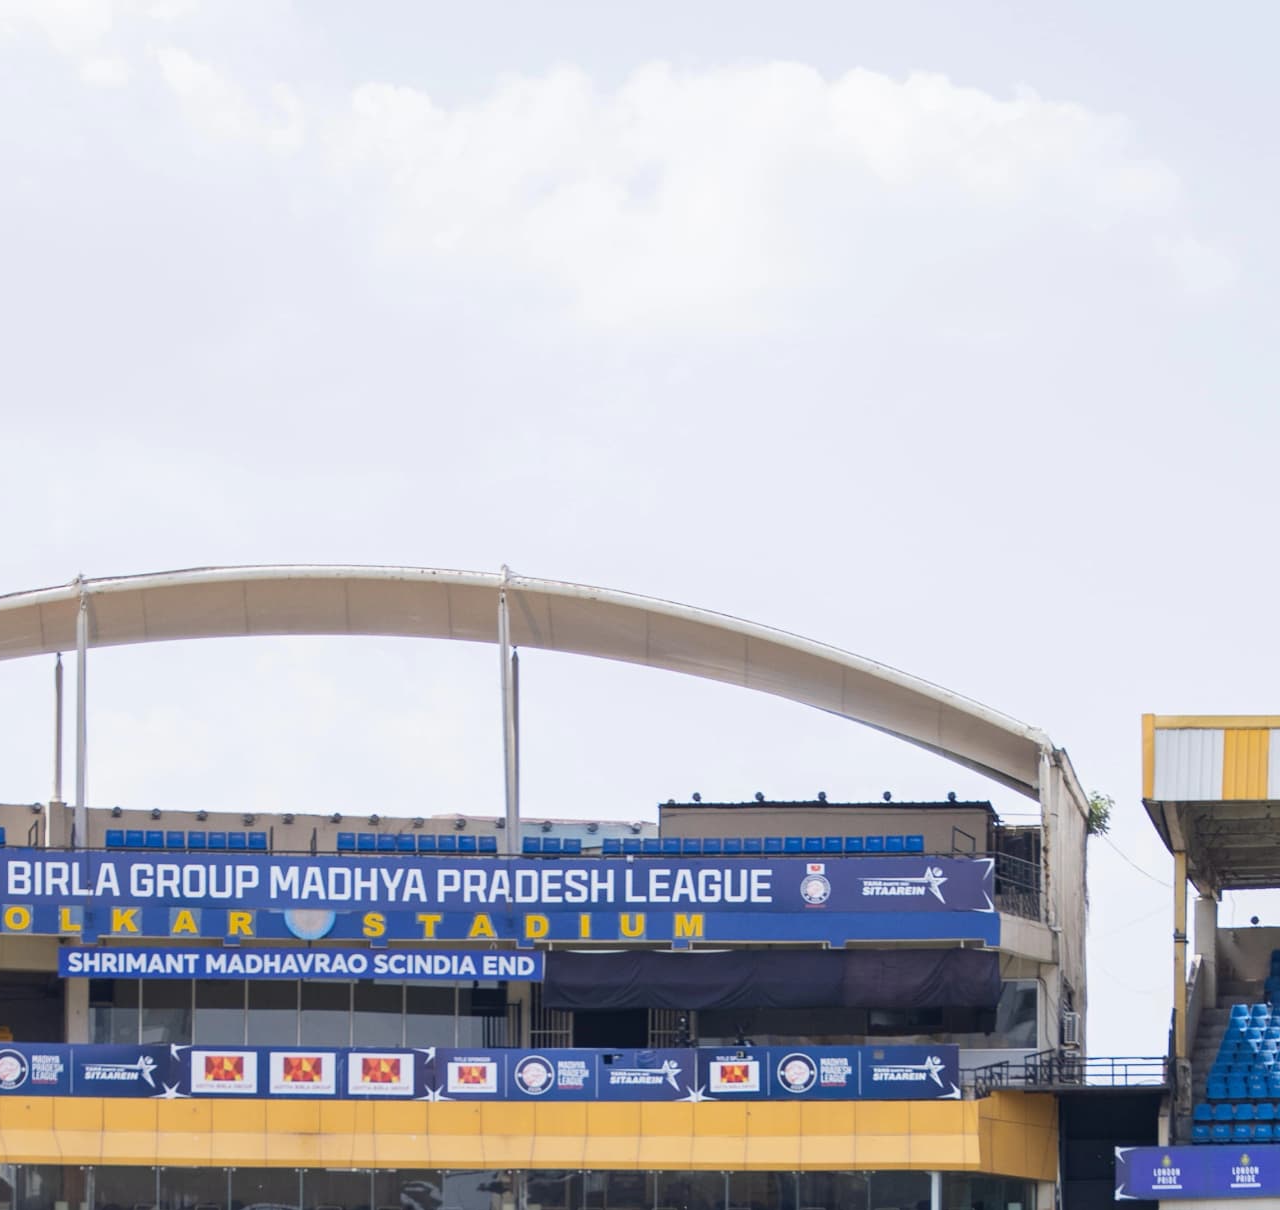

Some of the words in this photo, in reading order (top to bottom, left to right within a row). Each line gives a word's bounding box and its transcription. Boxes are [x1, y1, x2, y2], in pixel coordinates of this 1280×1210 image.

[7, 860, 120, 897] BIRLA
[130, 863, 260, 899] GROUP
[270, 865, 427, 902] MADHYA
[437, 868, 614, 903] PRADESH
[625, 868, 773, 903] LEAGUE
[862, 886, 925, 896] SITAAREIN
[68, 952, 200, 973] SHRIMANT
[205, 954, 367, 974] MADHAVRAO
[373, 953, 477, 975] SCINDIA
[482, 955, 534, 976] END
[85, 1072, 138, 1080] SITAAREIN
[873, 1073, 926, 1081] SITAAREIN
[1154, 1168, 1180, 1176] LONDON
[1232, 1166, 1259, 1175] LONDON
